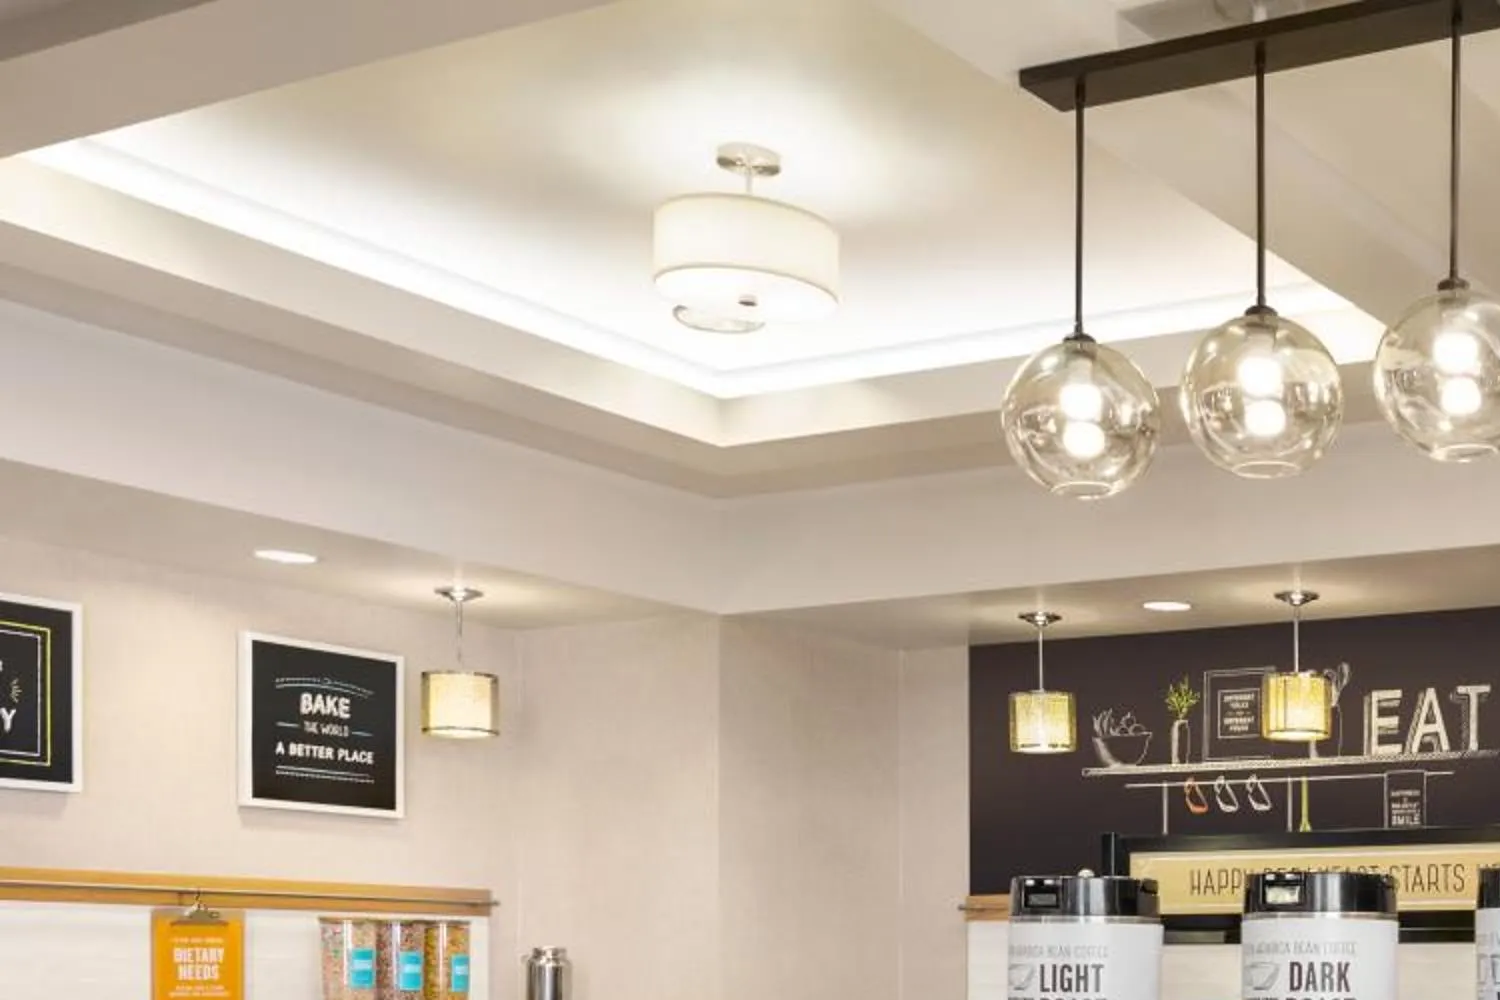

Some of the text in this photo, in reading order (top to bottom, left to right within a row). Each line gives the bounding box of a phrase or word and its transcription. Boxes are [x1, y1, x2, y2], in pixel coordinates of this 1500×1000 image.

[300, 692, 351, 719] BAKE
[1365, 684, 1491, 756] EAT
[275, 741, 374, 765] A BETTER PLACE
[173, 947, 225, 963] DIETARY
[178, 964, 219, 981] NEEDS
[1039, 963, 1105, 993] LIGHT
[1289, 961, 1351, 993] DARK
